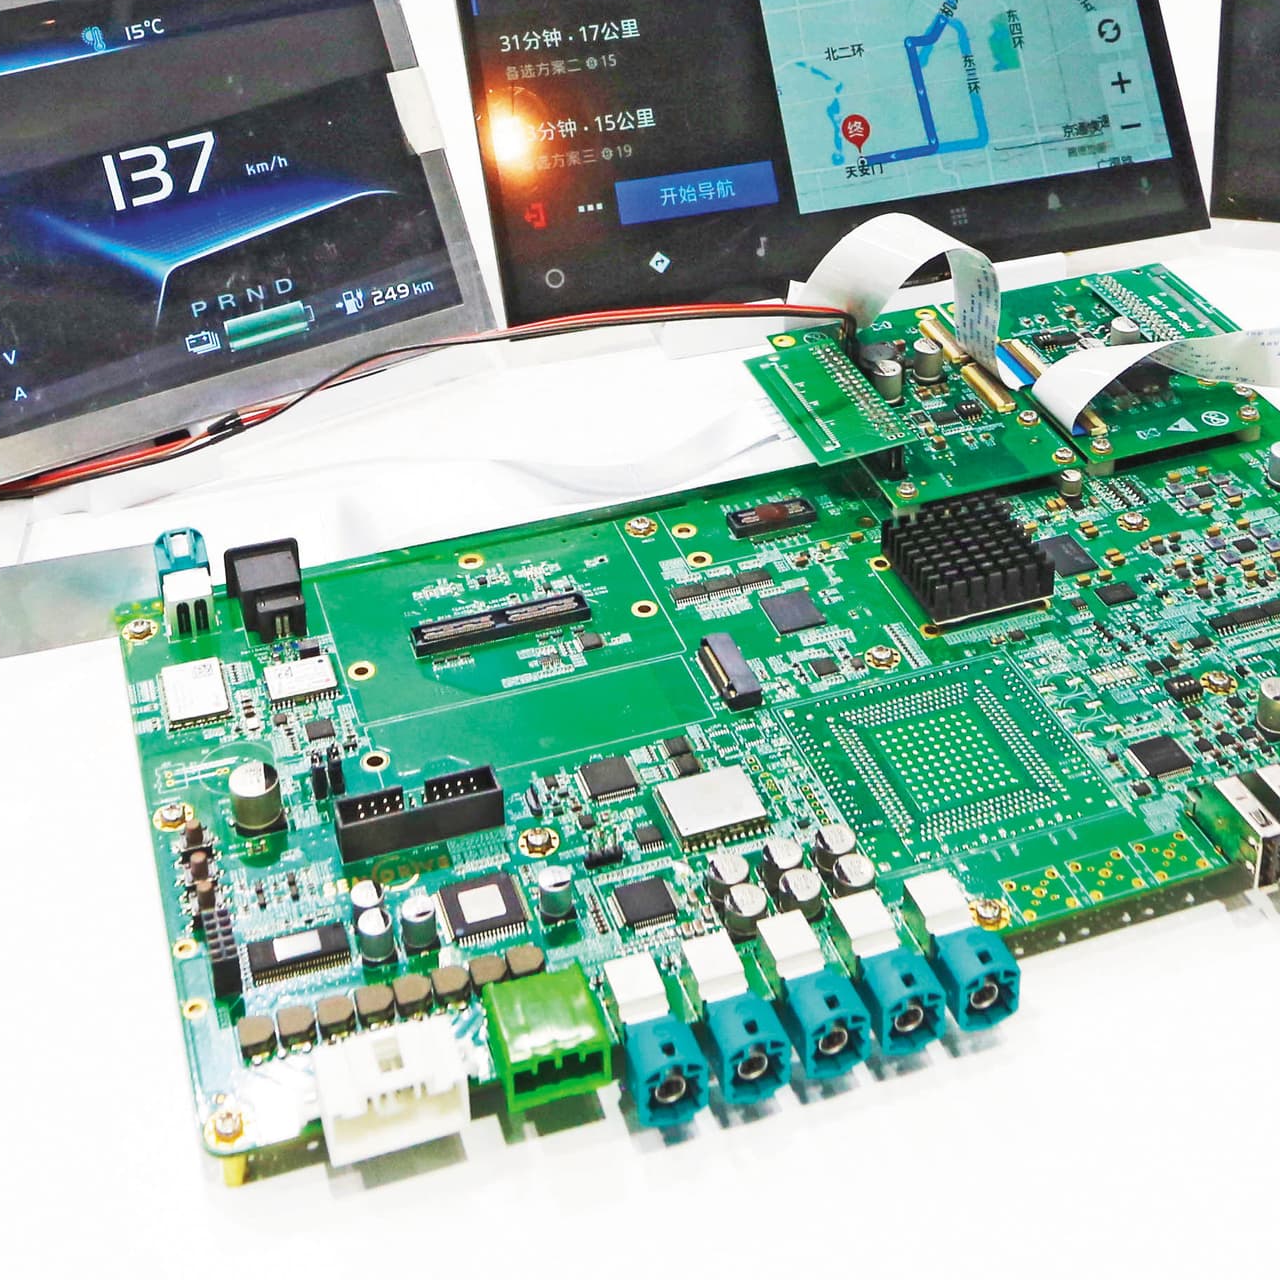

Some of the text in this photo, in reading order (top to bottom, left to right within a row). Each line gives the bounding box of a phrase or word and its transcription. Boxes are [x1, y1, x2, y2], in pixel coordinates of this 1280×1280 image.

[601, 54, 618, 69] 15
[824, 43, 866, 62] 北二环
[962, 54, 982, 95] 东三环
[847, 119, 866, 138] 终
[616, 143, 633, 159] 19
[101, 130, 289, 212] 137 km/h
[659, 178, 737, 208] 开始导航
[191, 277, 294, 318] P R N D
[370, 279, 436, 307] 249 km
[2, 349, 18, 366] V
[13, 385, 29, 402] A
